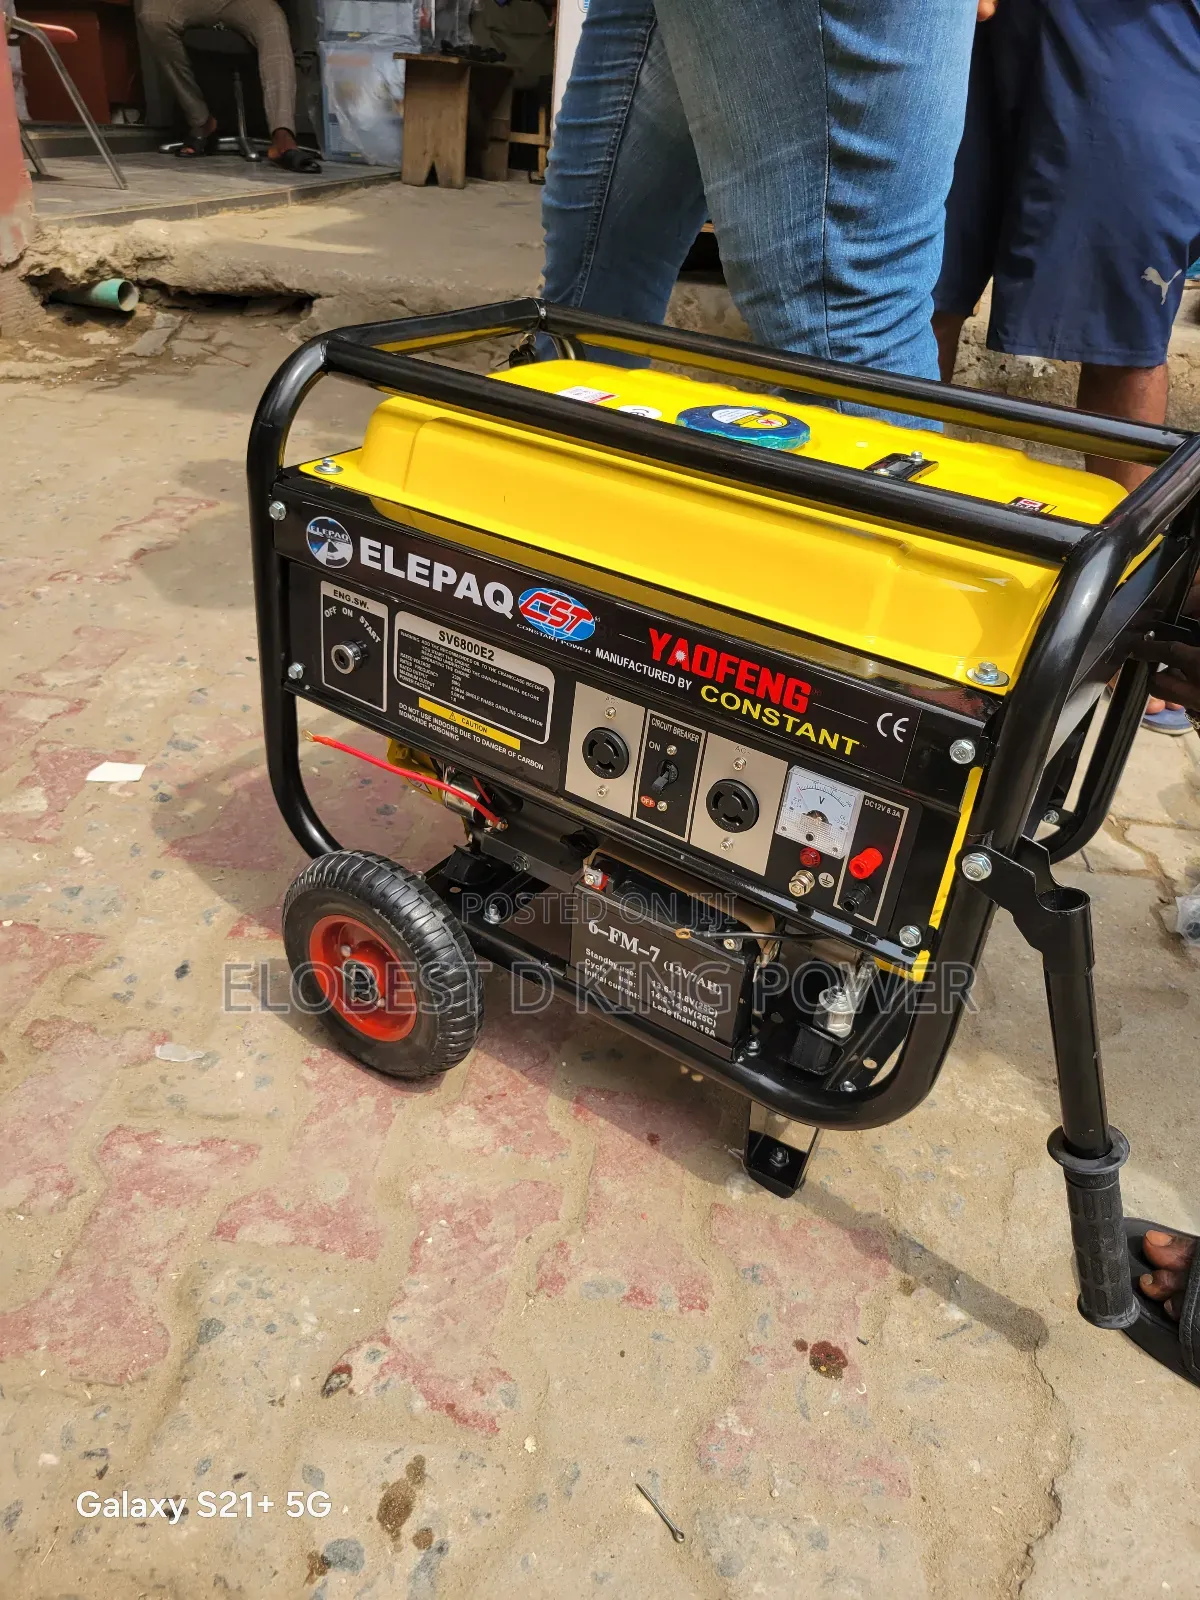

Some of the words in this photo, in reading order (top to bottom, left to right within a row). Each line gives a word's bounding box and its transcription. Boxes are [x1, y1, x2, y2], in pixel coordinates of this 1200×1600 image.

[310, 525, 349, 541] ELEPAQ
[360, 536, 514, 619] ELEPAQ
[333, 589, 369, 610] ENG.SW.
[519, 590, 594, 634] CST
[324, 606, 338, 618] OFF
[342, 607, 354, 617] ON
[360, 615, 381, 643] START
[516, 623, 558, 642] CONSTANT
[560, 640, 591, 654] POWER
[438, 630, 495, 662] SV6800E2
[595, 647, 676, 685] MANUFACTURED
[677, 677, 693, 690] BY
[649, 627, 812, 714] YAOFENG
[398, 709, 428, 727] MONOXIDE
[461, 717, 488, 733] CAUTION
[651, 717, 673, 733] CIRCUIT
[672, 726, 700, 743] BREAKER
[700, 685, 860, 756] CONSTANT
[876, 712, 909, 742] CE
[399, 702, 407, 712] DO
[408, 706, 419, 717] NOT
[420, 711, 431, 722] USE
[433, 717, 458, 734] INDOORS
[460, 729, 471, 740] DUE
[472, 735, 481, 743] TO
[481, 738, 507, 755] DANGER
[508, 750, 517, 758] OF
[517, 753, 544, 771] CARBON
[648, 740, 661, 752] ON
[641, 796, 655, 806] OFF
[819, 795, 825, 804] V
[864, 798, 886, 812] DC12V
[588, 919, 660, 963] 6-FM-7
[584, 958, 607, 974] Cycle
[618, 975, 637, 988] use:
[585, 947, 618, 970] Standby
[619, 964, 638, 978] use:
[584, 967, 607, 985] Initial
[607, 981, 641, 1000] current:
